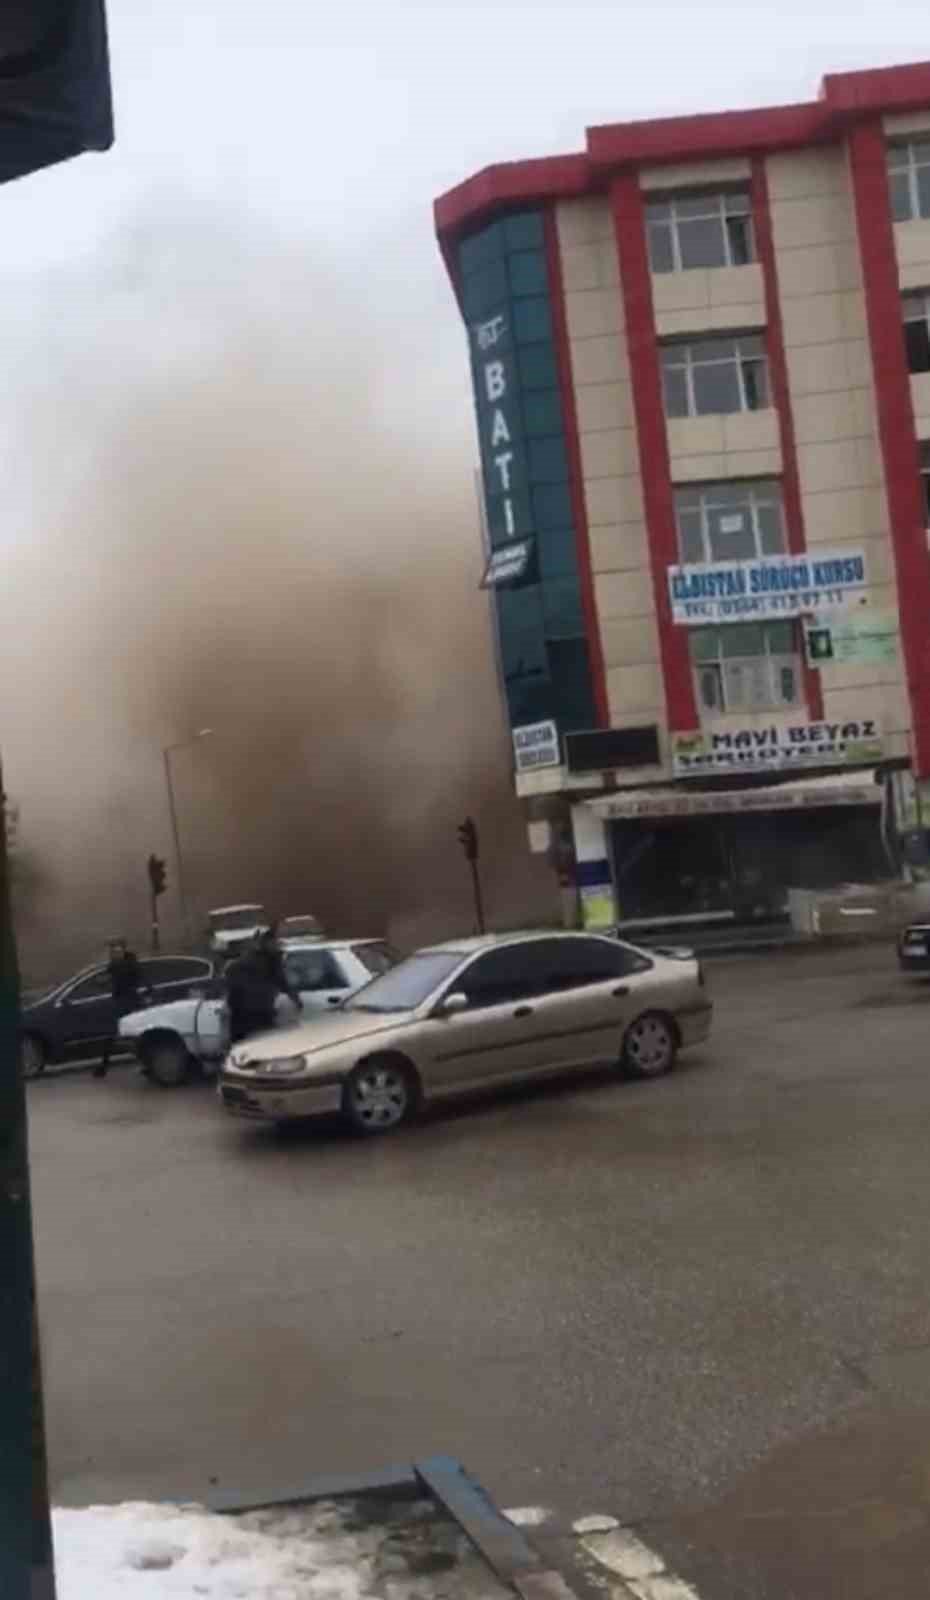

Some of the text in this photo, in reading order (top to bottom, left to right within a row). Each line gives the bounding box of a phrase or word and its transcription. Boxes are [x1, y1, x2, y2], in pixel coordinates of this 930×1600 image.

[813, 557, 865, 587] KURSU
[712, 721, 876, 749] MAVİ BEYAZ
